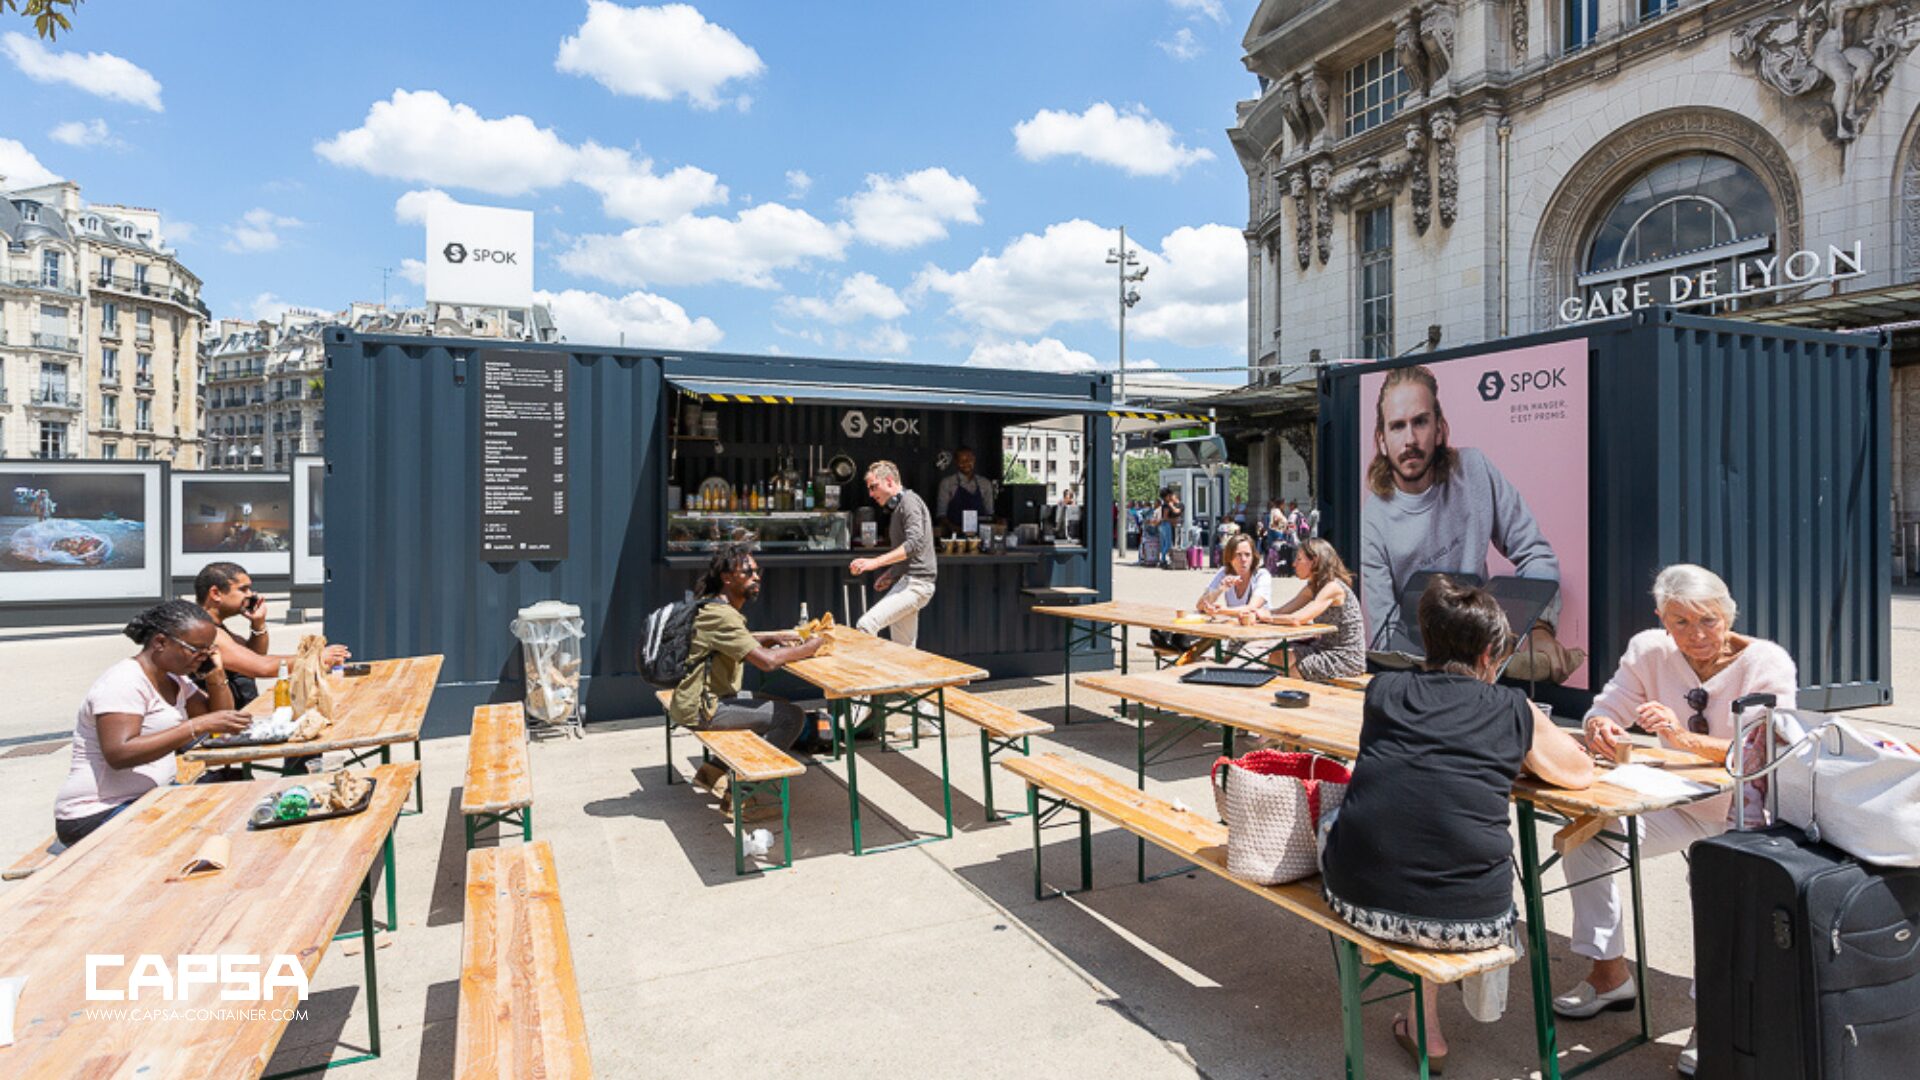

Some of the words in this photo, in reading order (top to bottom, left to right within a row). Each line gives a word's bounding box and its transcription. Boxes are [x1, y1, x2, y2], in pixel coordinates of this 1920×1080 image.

[473, 249, 517, 265] SPOK
[1560, 282, 1650, 322] GARE
[1670, 269, 1717, 303] DE
[1739, 240, 1863, 291] LYON
[1510, 367, 1567, 393] SPOK
[873, 417, 920, 435] SPOK
